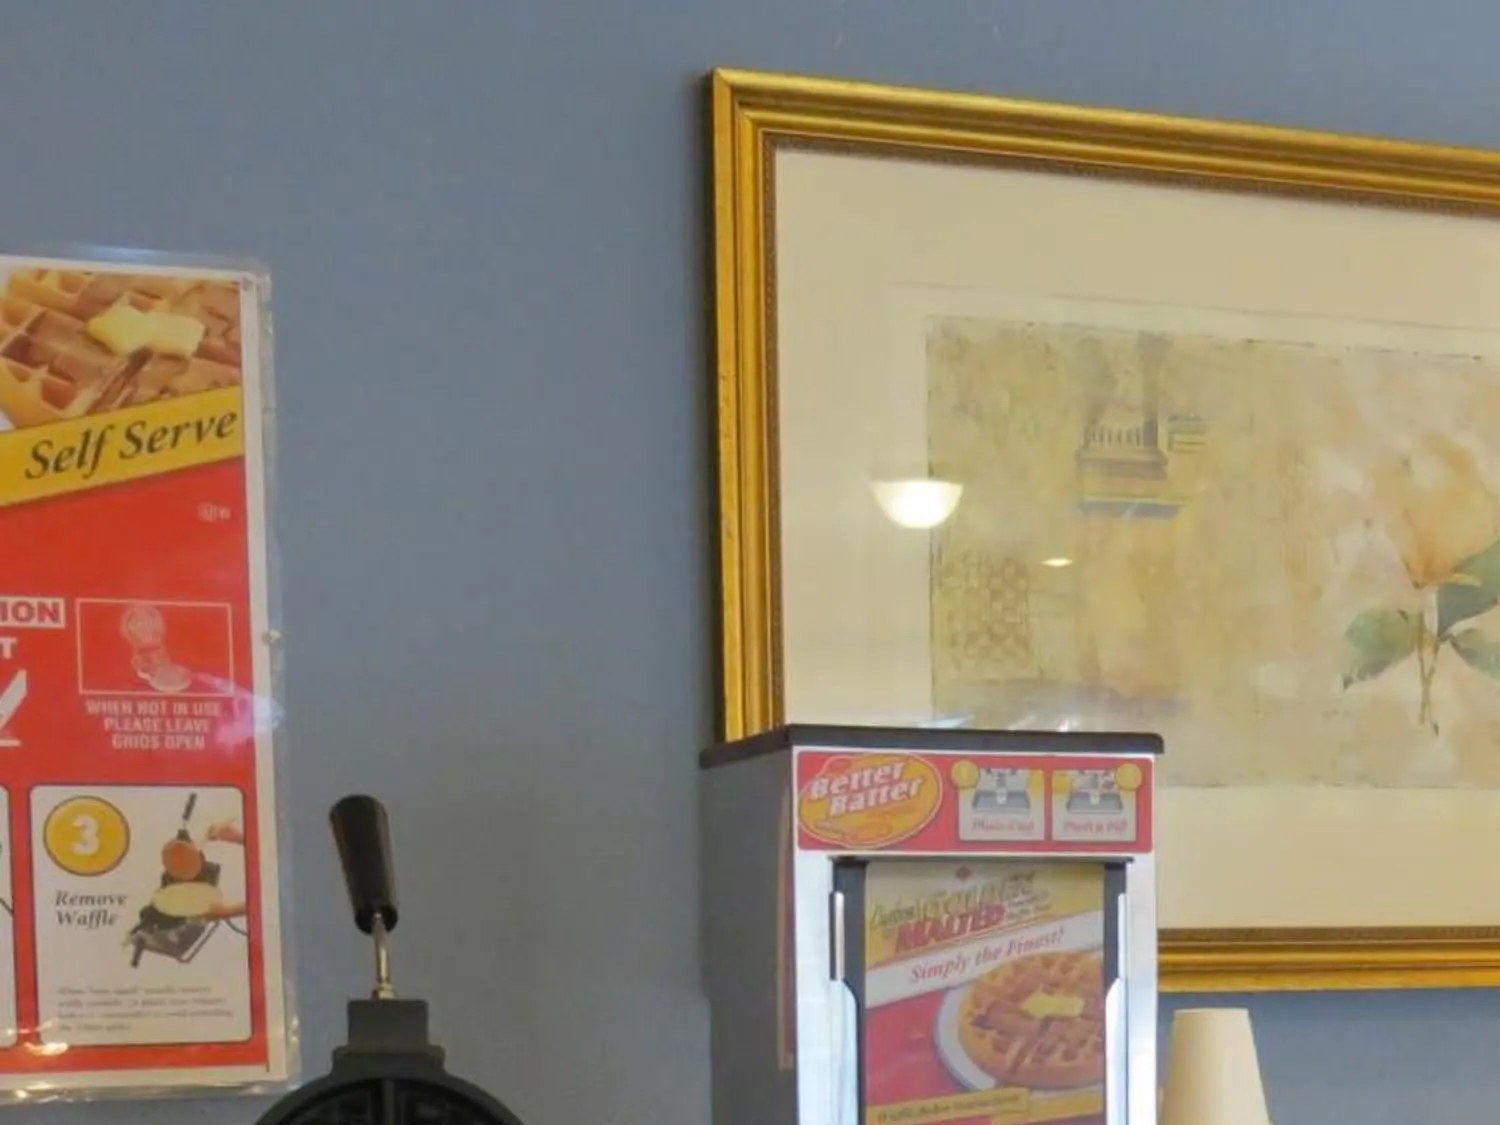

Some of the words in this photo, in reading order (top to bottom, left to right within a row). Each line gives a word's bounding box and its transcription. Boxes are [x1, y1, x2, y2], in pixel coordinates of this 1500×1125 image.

[24, 425, 115, 480] Self
[118, 408, 238, 461] Serve
[137, 701, 167, 716] NOT
[173, 702, 189, 716] IN
[104, 717, 161, 733] PLEASE
[166, 718, 211, 733] LEAVE
[164, 734, 205, 750] OPEN
[808, 762, 906, 800] Better
[830, 777, 924, 817] Batter
[70, 814, 101, 856] 3
[55, 890, 127, 907] Remove
[55, 911, 119, 929] Waffle
[909, 952, 971, 984] Simply
[975, 945, 1002, 967] the
